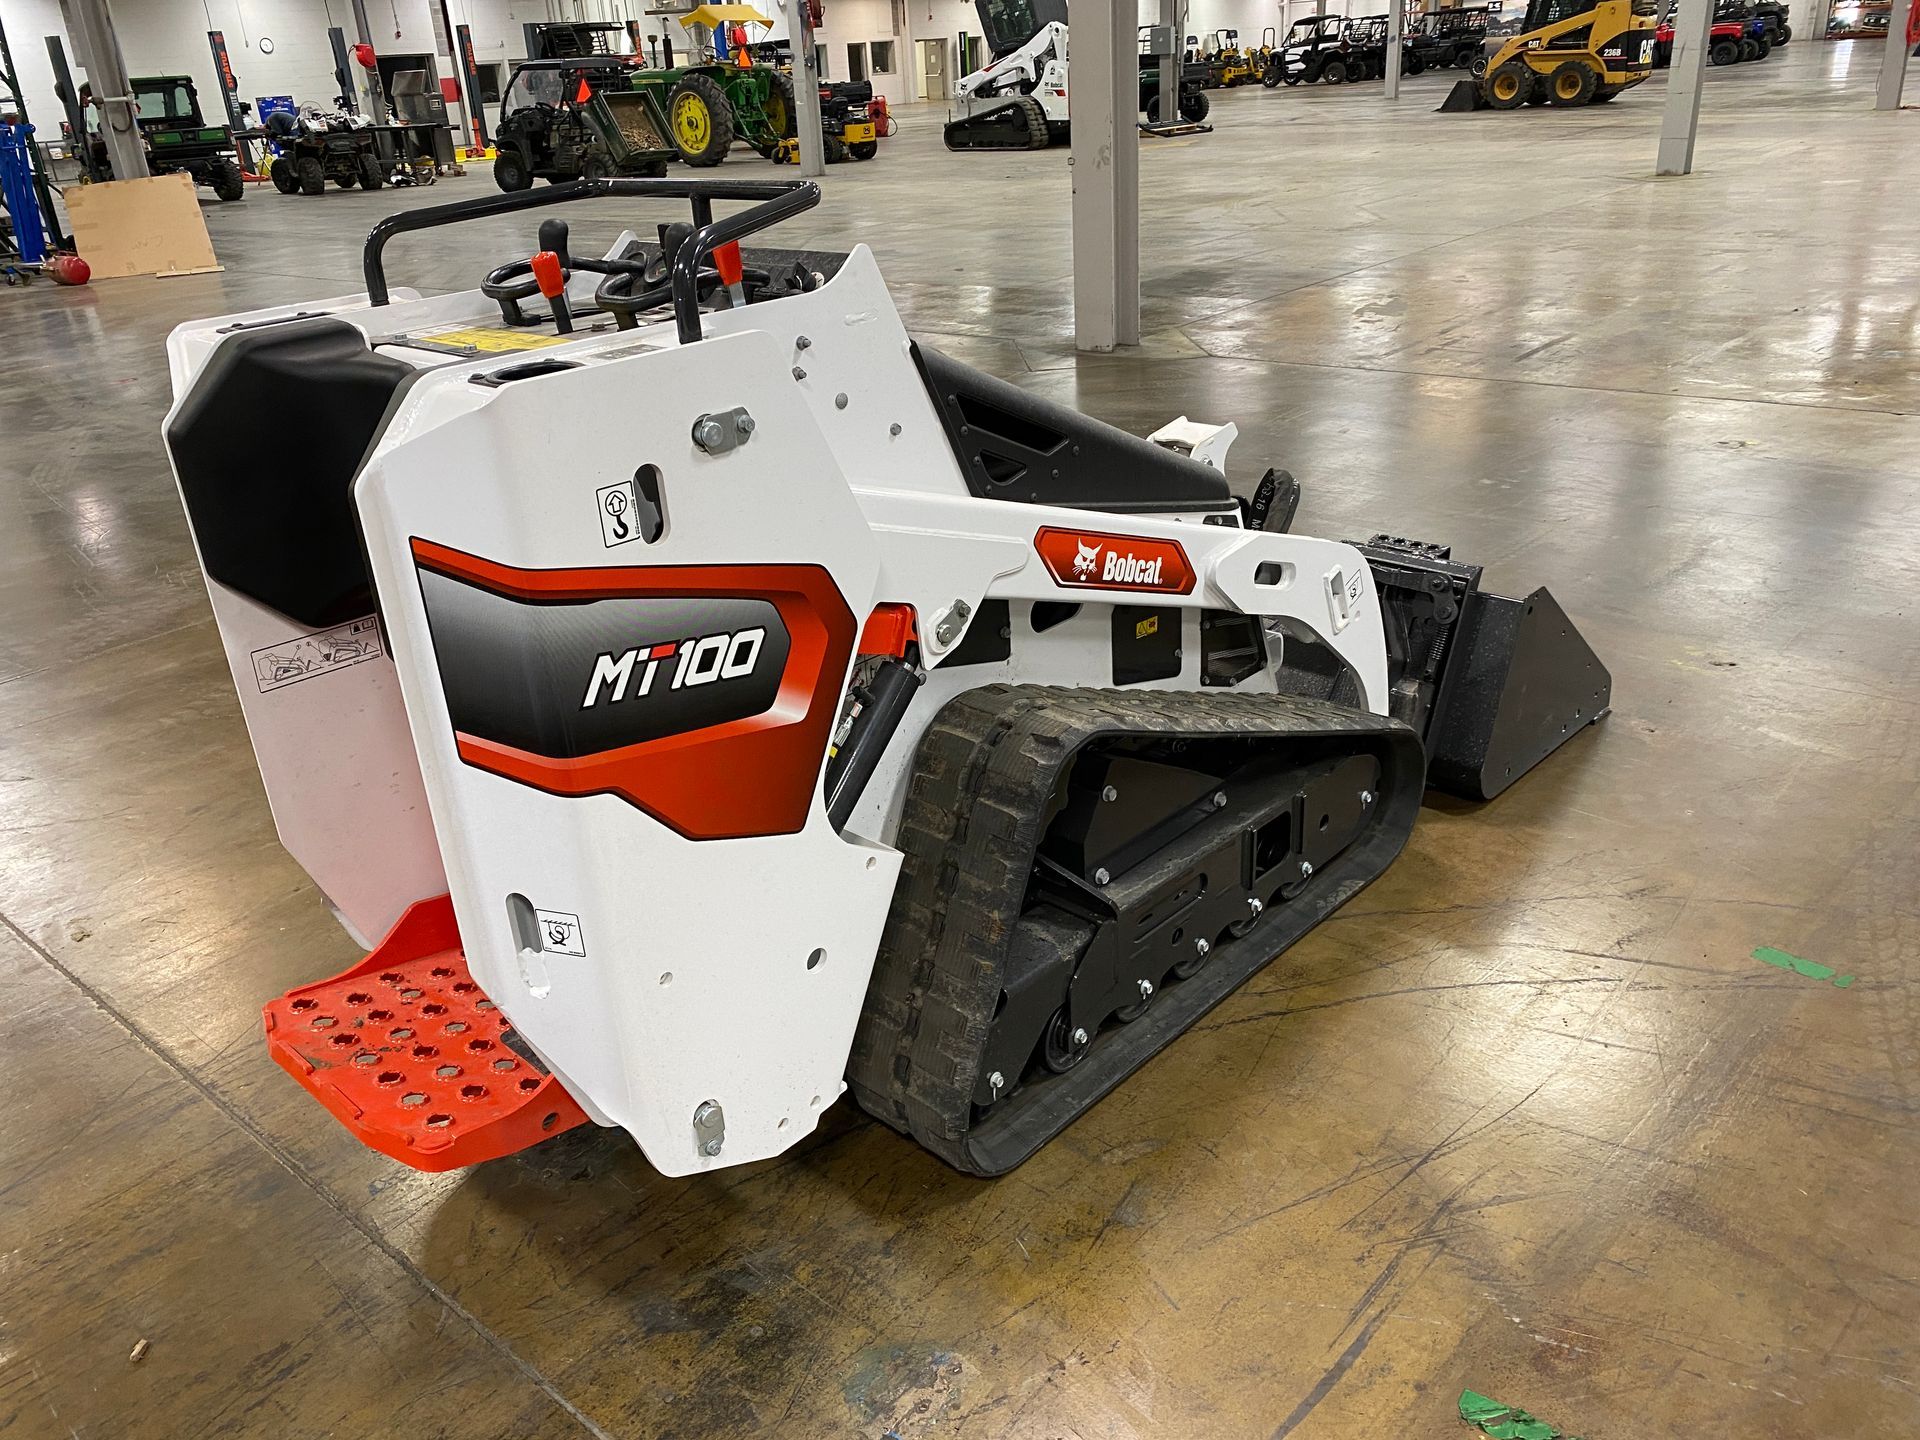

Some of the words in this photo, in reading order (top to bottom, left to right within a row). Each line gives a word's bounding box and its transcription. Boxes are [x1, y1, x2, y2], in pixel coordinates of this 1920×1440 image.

[1528, 40, 1540, 48] CAT
[1603, 48, 1621, 56] 236B
[1639, 39, 1655, 64] CAT
[219, 50, 235, 89] STRATUS
[1102, 550, 1163, 585] Bobcat
[582, 627, 765, 708] MT100
